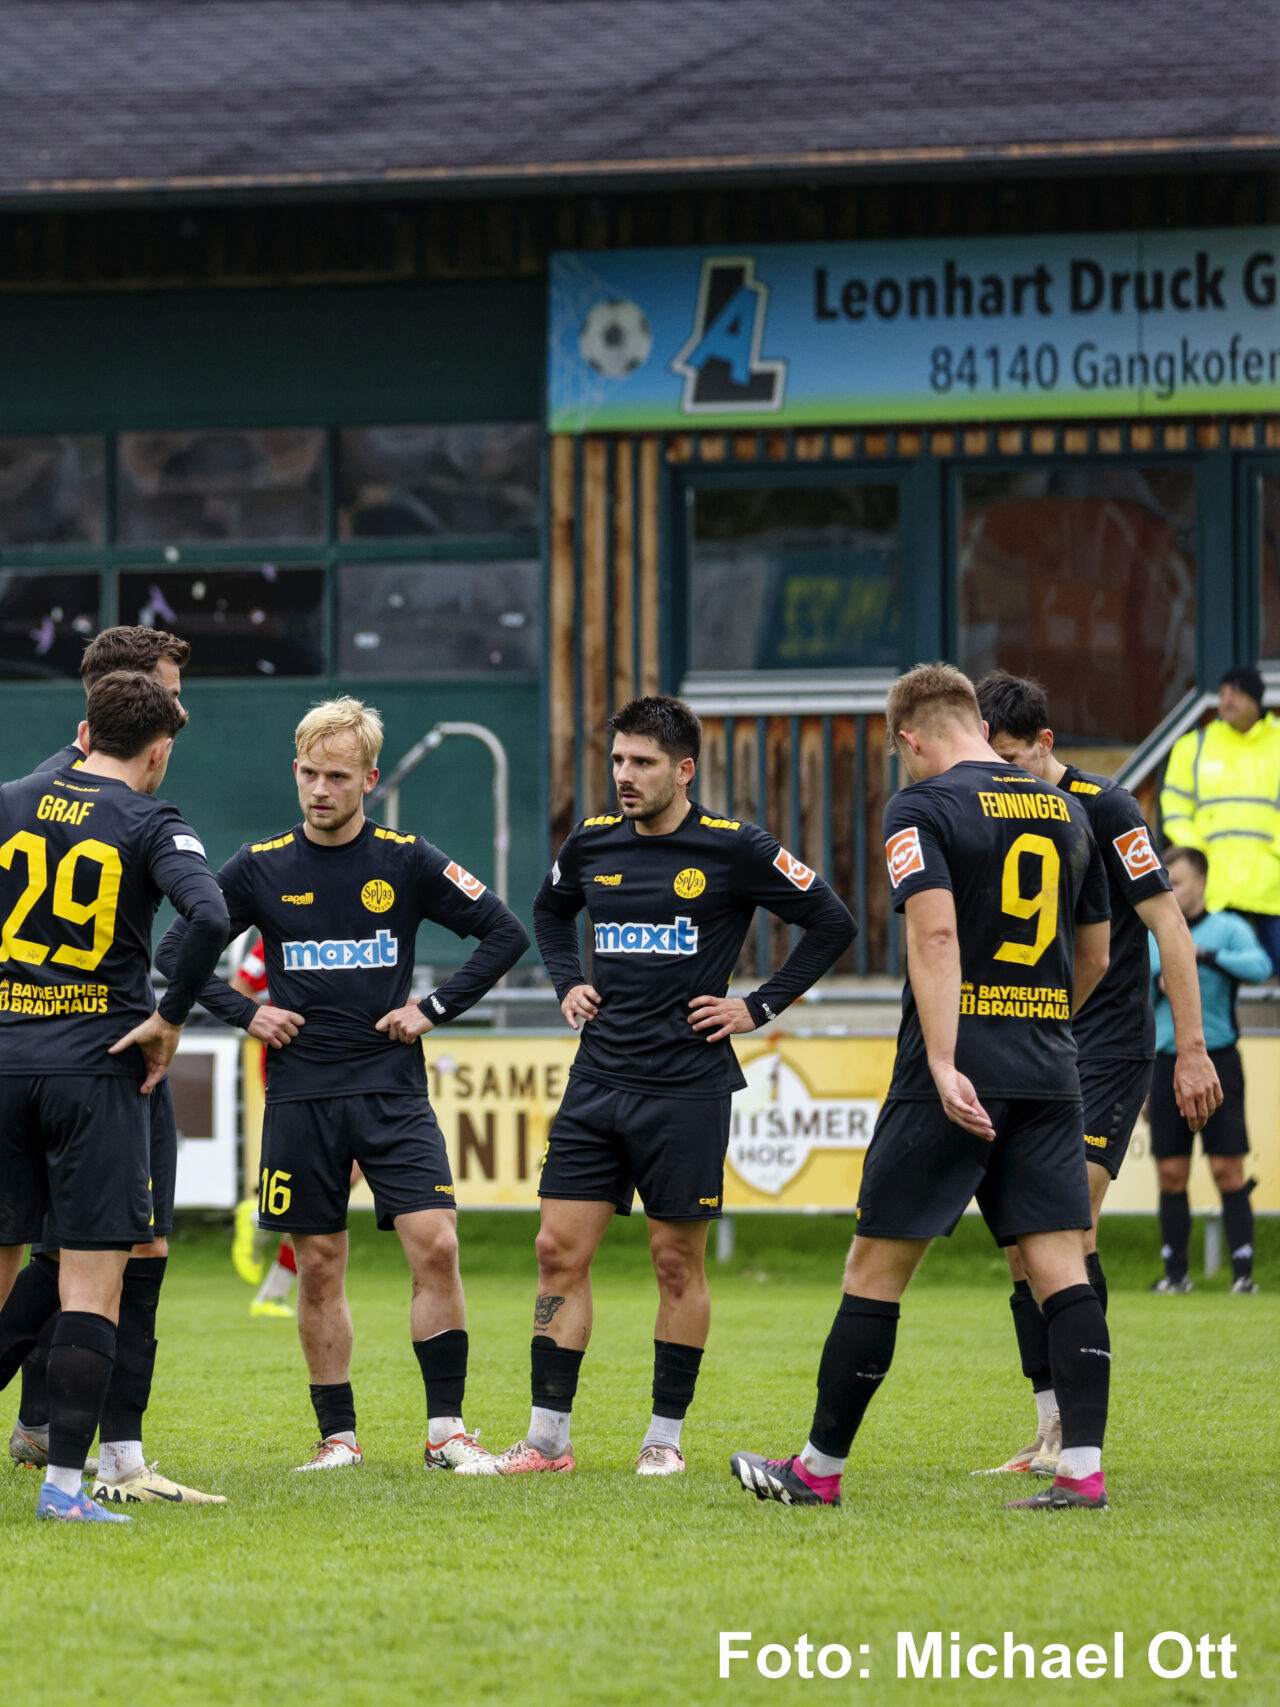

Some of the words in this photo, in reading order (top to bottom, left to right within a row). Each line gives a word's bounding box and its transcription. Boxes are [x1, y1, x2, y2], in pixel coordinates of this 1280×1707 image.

[813, 258, 1053, 322] Leonhart
[1069, 251, 1226, 316] Druck
[929, 342, 1059, 394] 84140
[36, 794, 95, 826] GRAF
[977, 791, 1072, 823] FENNINGER
[281, 892, 314, 903] capelli
[992, 832, 1061, 967] 9
[283, 931, 397, 968] maxit
[594, 918, 697, 954] maxit
[10, 997, 108, 1016] BRAUHAUS
[11, 982, 109, 1000] BAYREUTHER
[978, 985, 1069, 1003] BAYREUTHE
[261, 1168, 292, 1216] 16
